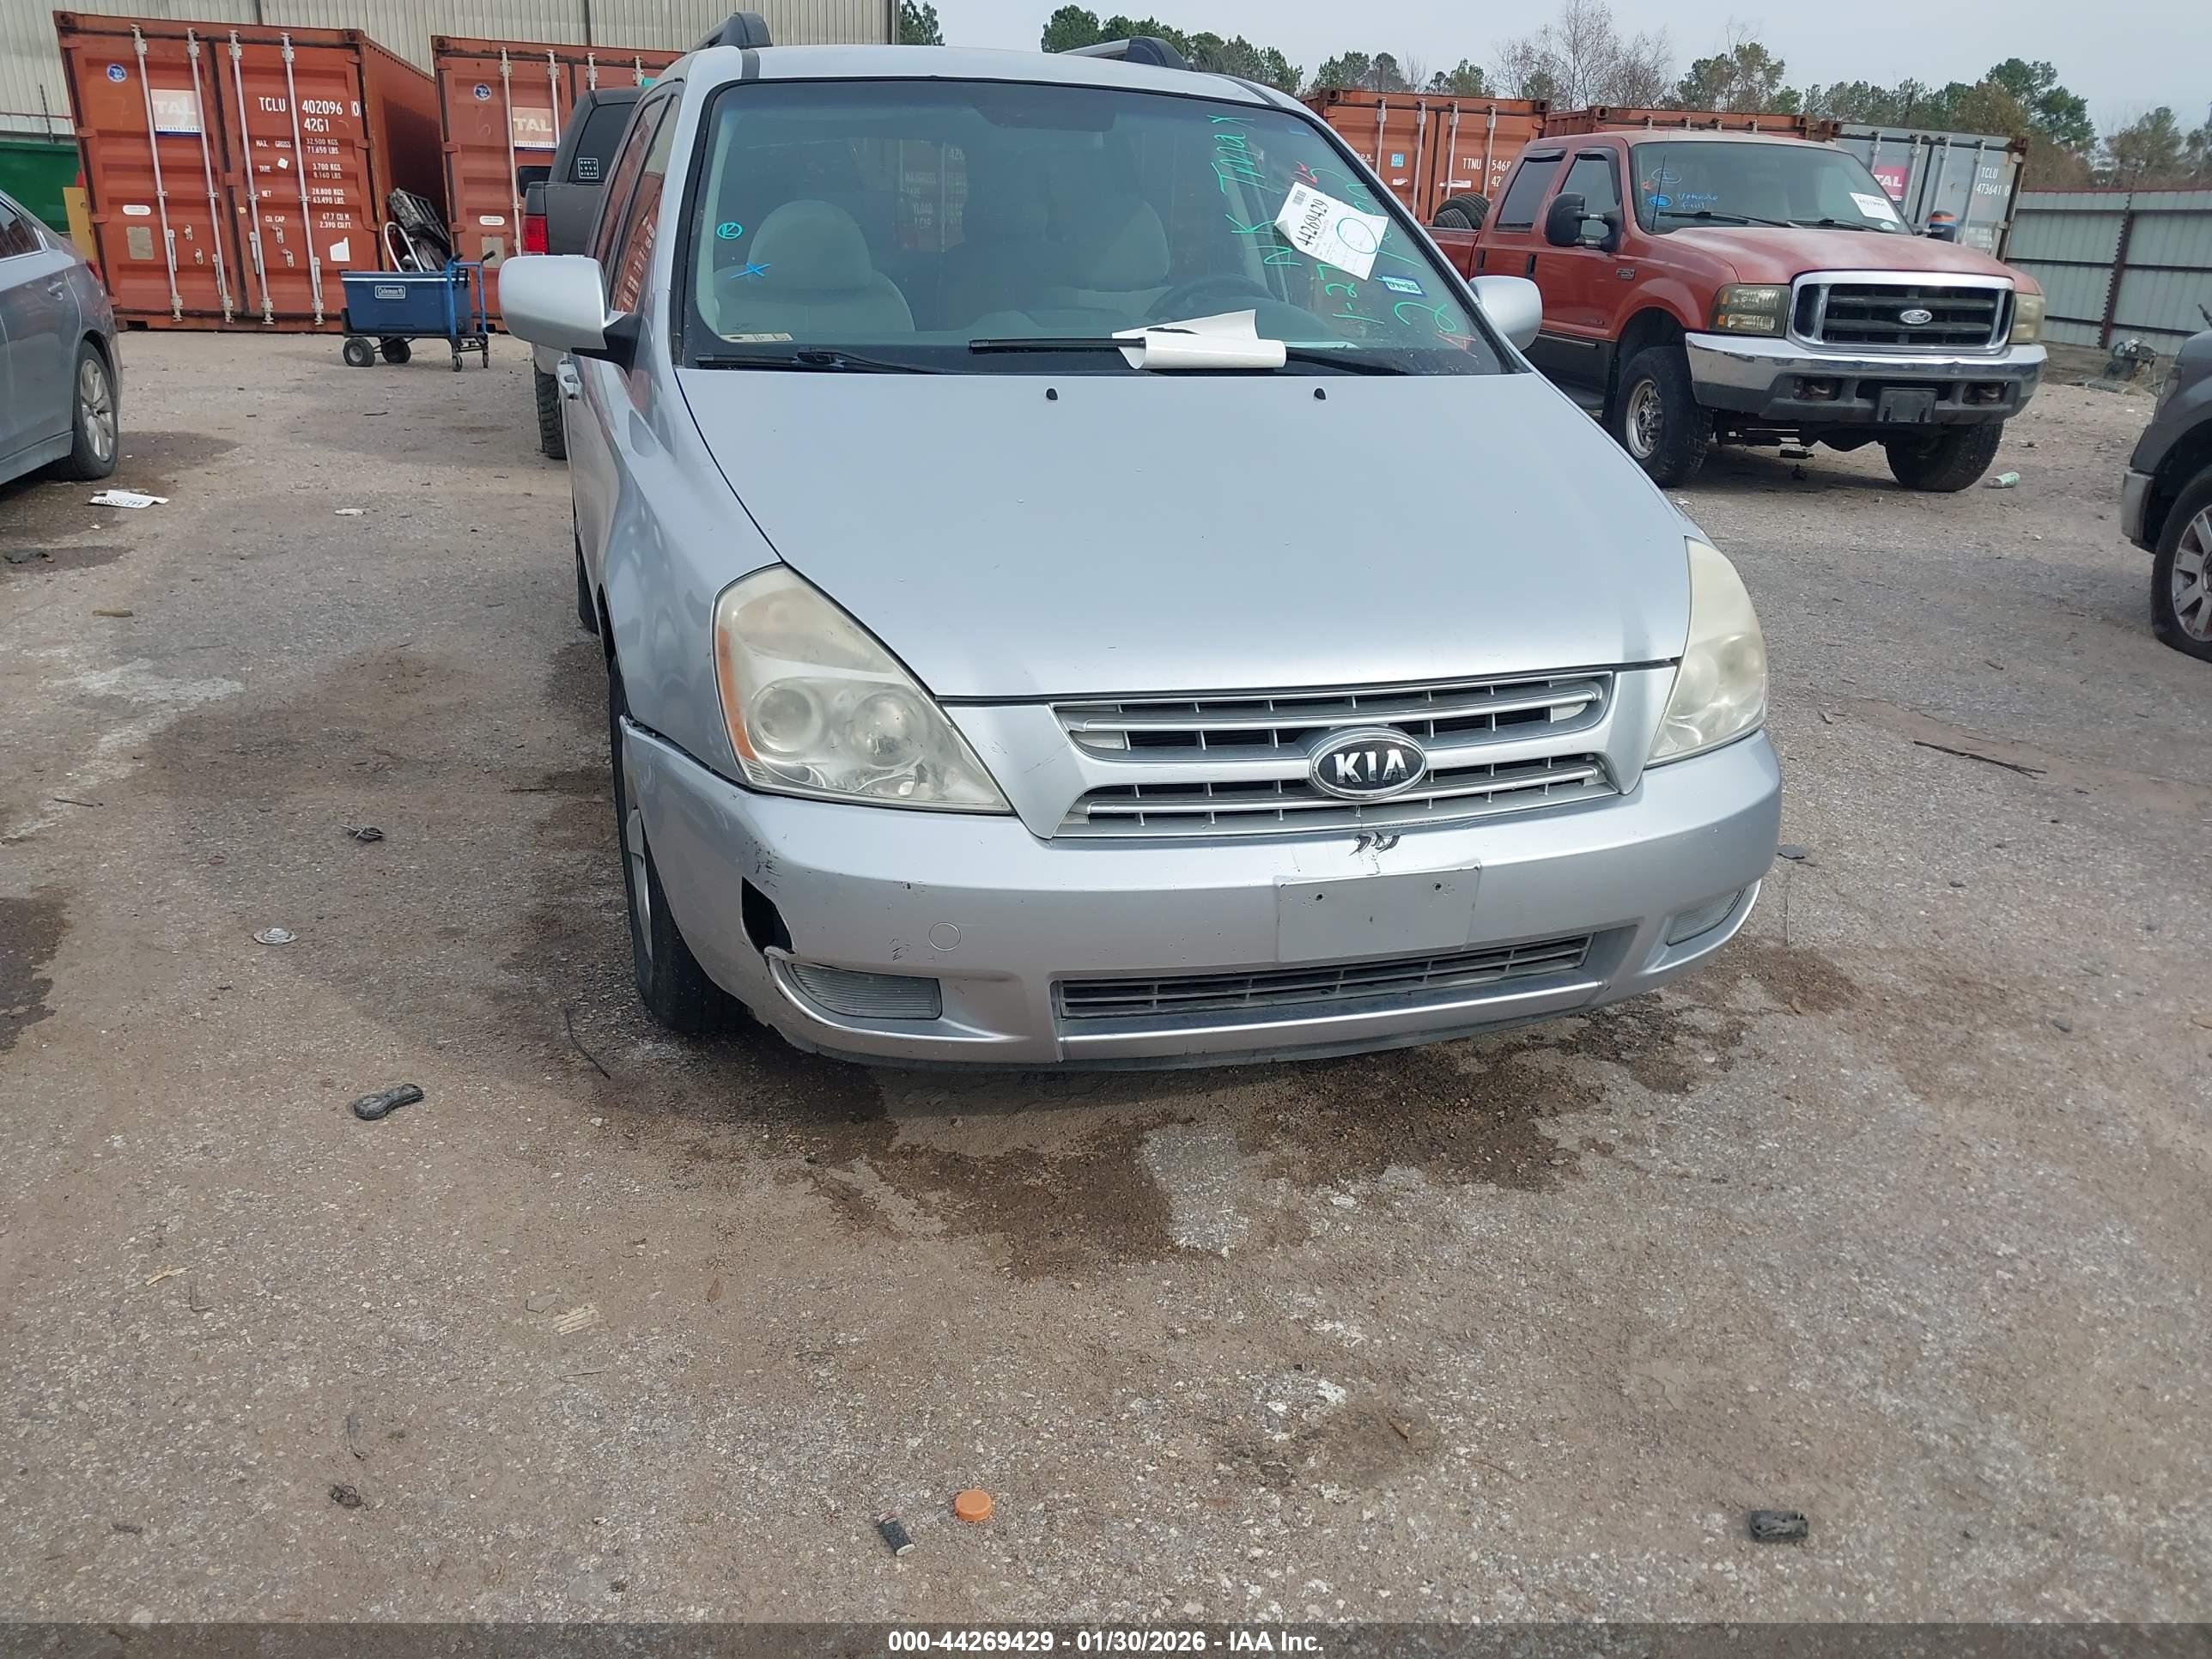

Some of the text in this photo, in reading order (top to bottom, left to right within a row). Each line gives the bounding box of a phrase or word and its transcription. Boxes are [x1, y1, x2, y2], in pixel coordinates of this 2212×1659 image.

[258, 97, 360, 116] TCLU 402096 0
[304, 118, 330, 132] 42G1
[514, 118, 552, 131] TAL
[1463, 158, 1481, 169] TTNU
[1981, 167, 1998, 179] TCLU
[1977, 183, 2010, 196] 473641 0
[1296, 198, 1329, 246] 44269429
[1333, 749, 1409, 784] KIA
